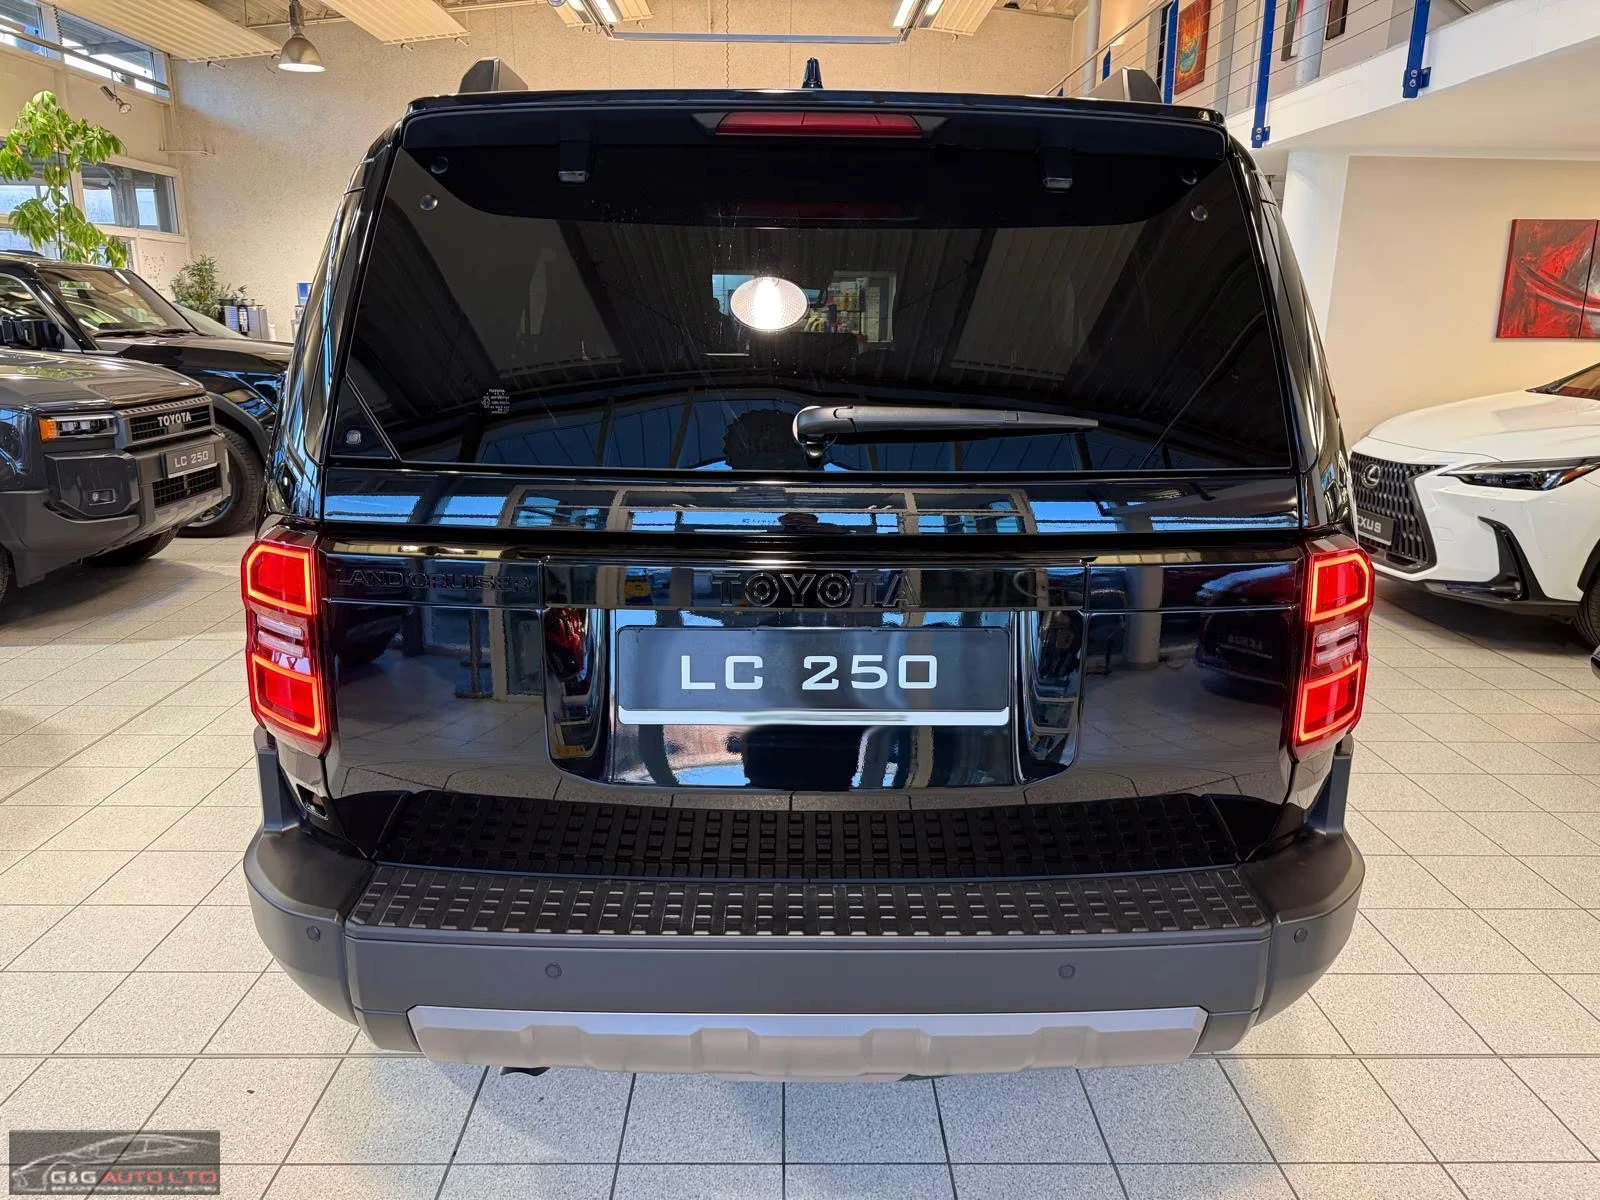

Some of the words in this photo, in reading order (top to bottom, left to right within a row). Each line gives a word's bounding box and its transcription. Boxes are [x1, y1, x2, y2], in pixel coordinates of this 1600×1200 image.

[157, 411, 192, 427] TOYOTA
[174, 455, 188, 468] LC
[190, 450, 209, 464] 250
[335, 568, 404, 588] LAND
[408, 571, 534, 593] CRUISER
[711, 572, 920, 608] TOYOTA
[680, 654, 764, 690] LC
[801, 654, 938, 691] 250
